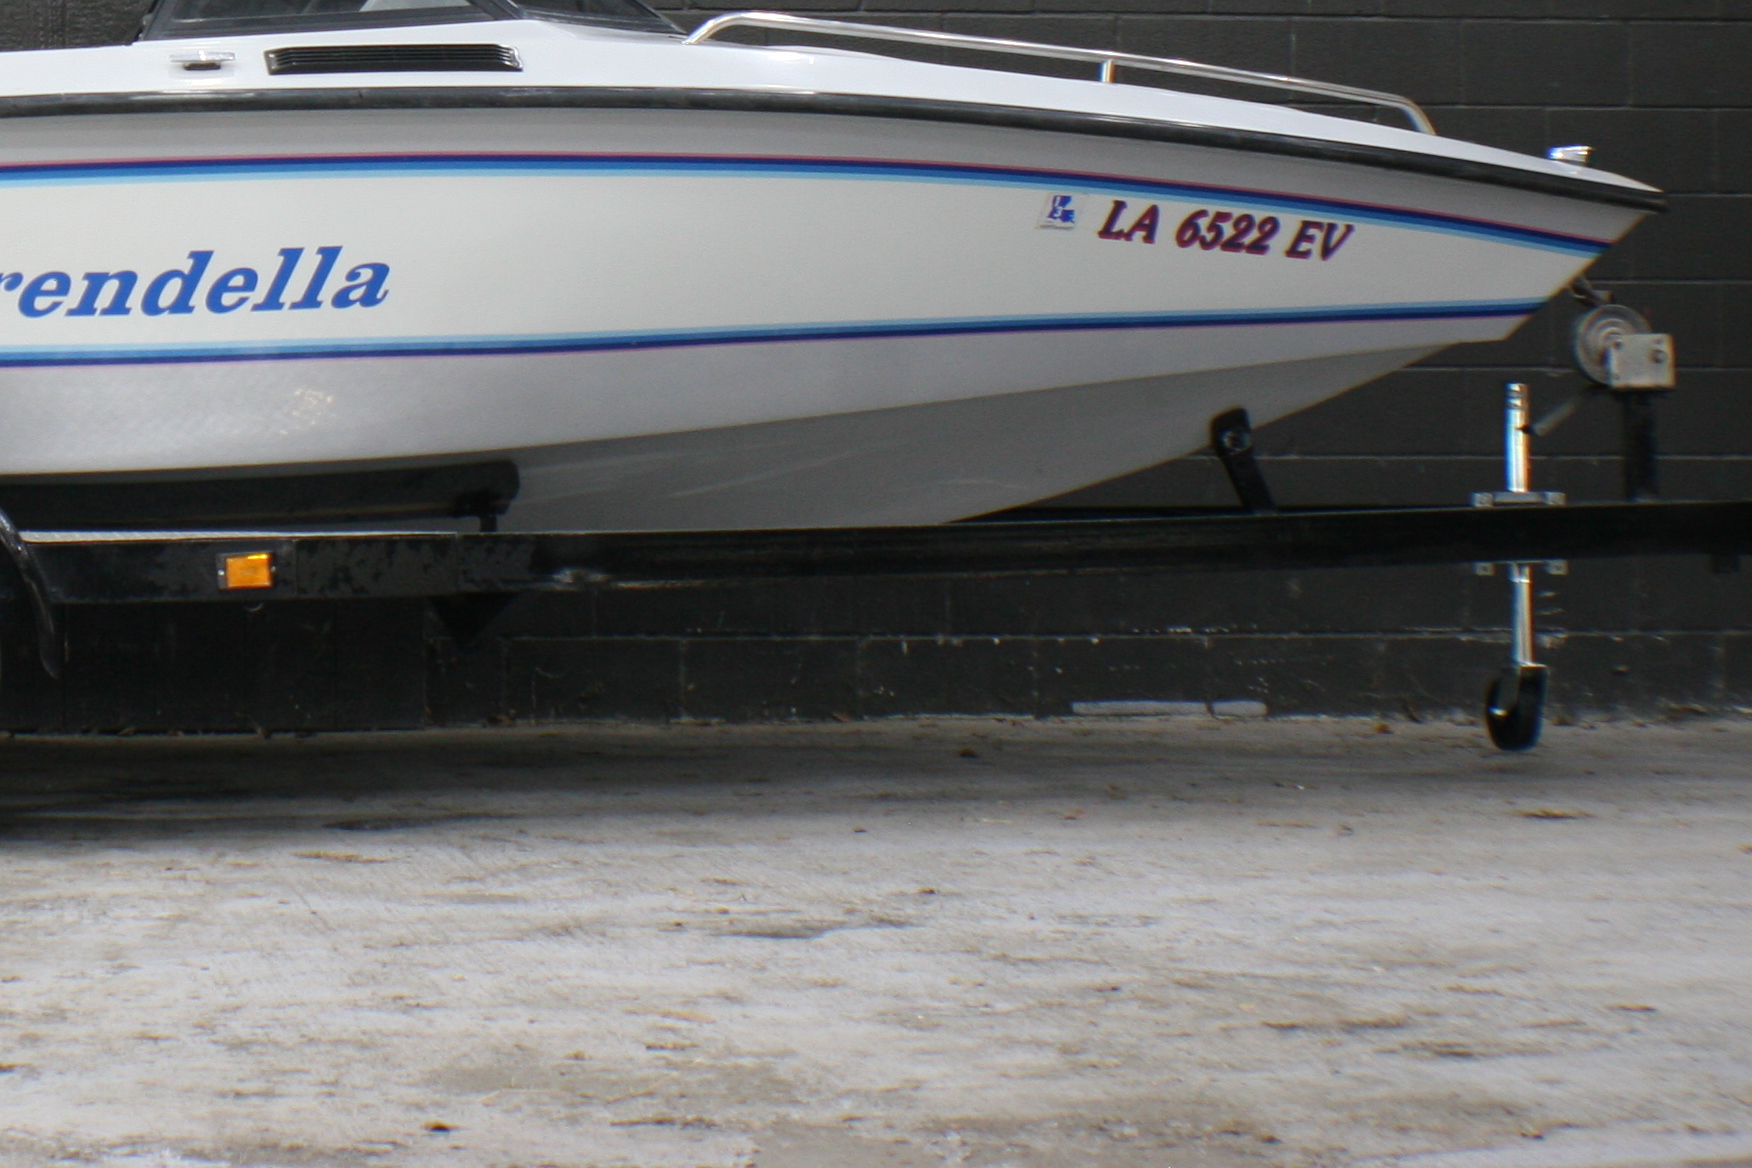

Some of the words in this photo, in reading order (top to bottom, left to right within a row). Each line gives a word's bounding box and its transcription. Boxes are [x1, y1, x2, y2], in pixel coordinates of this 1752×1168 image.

[1097, 200, 1159, 244] LA
[1175, 208, 1280, 255] 6522
[1285, 219, 1355, 261] EV
